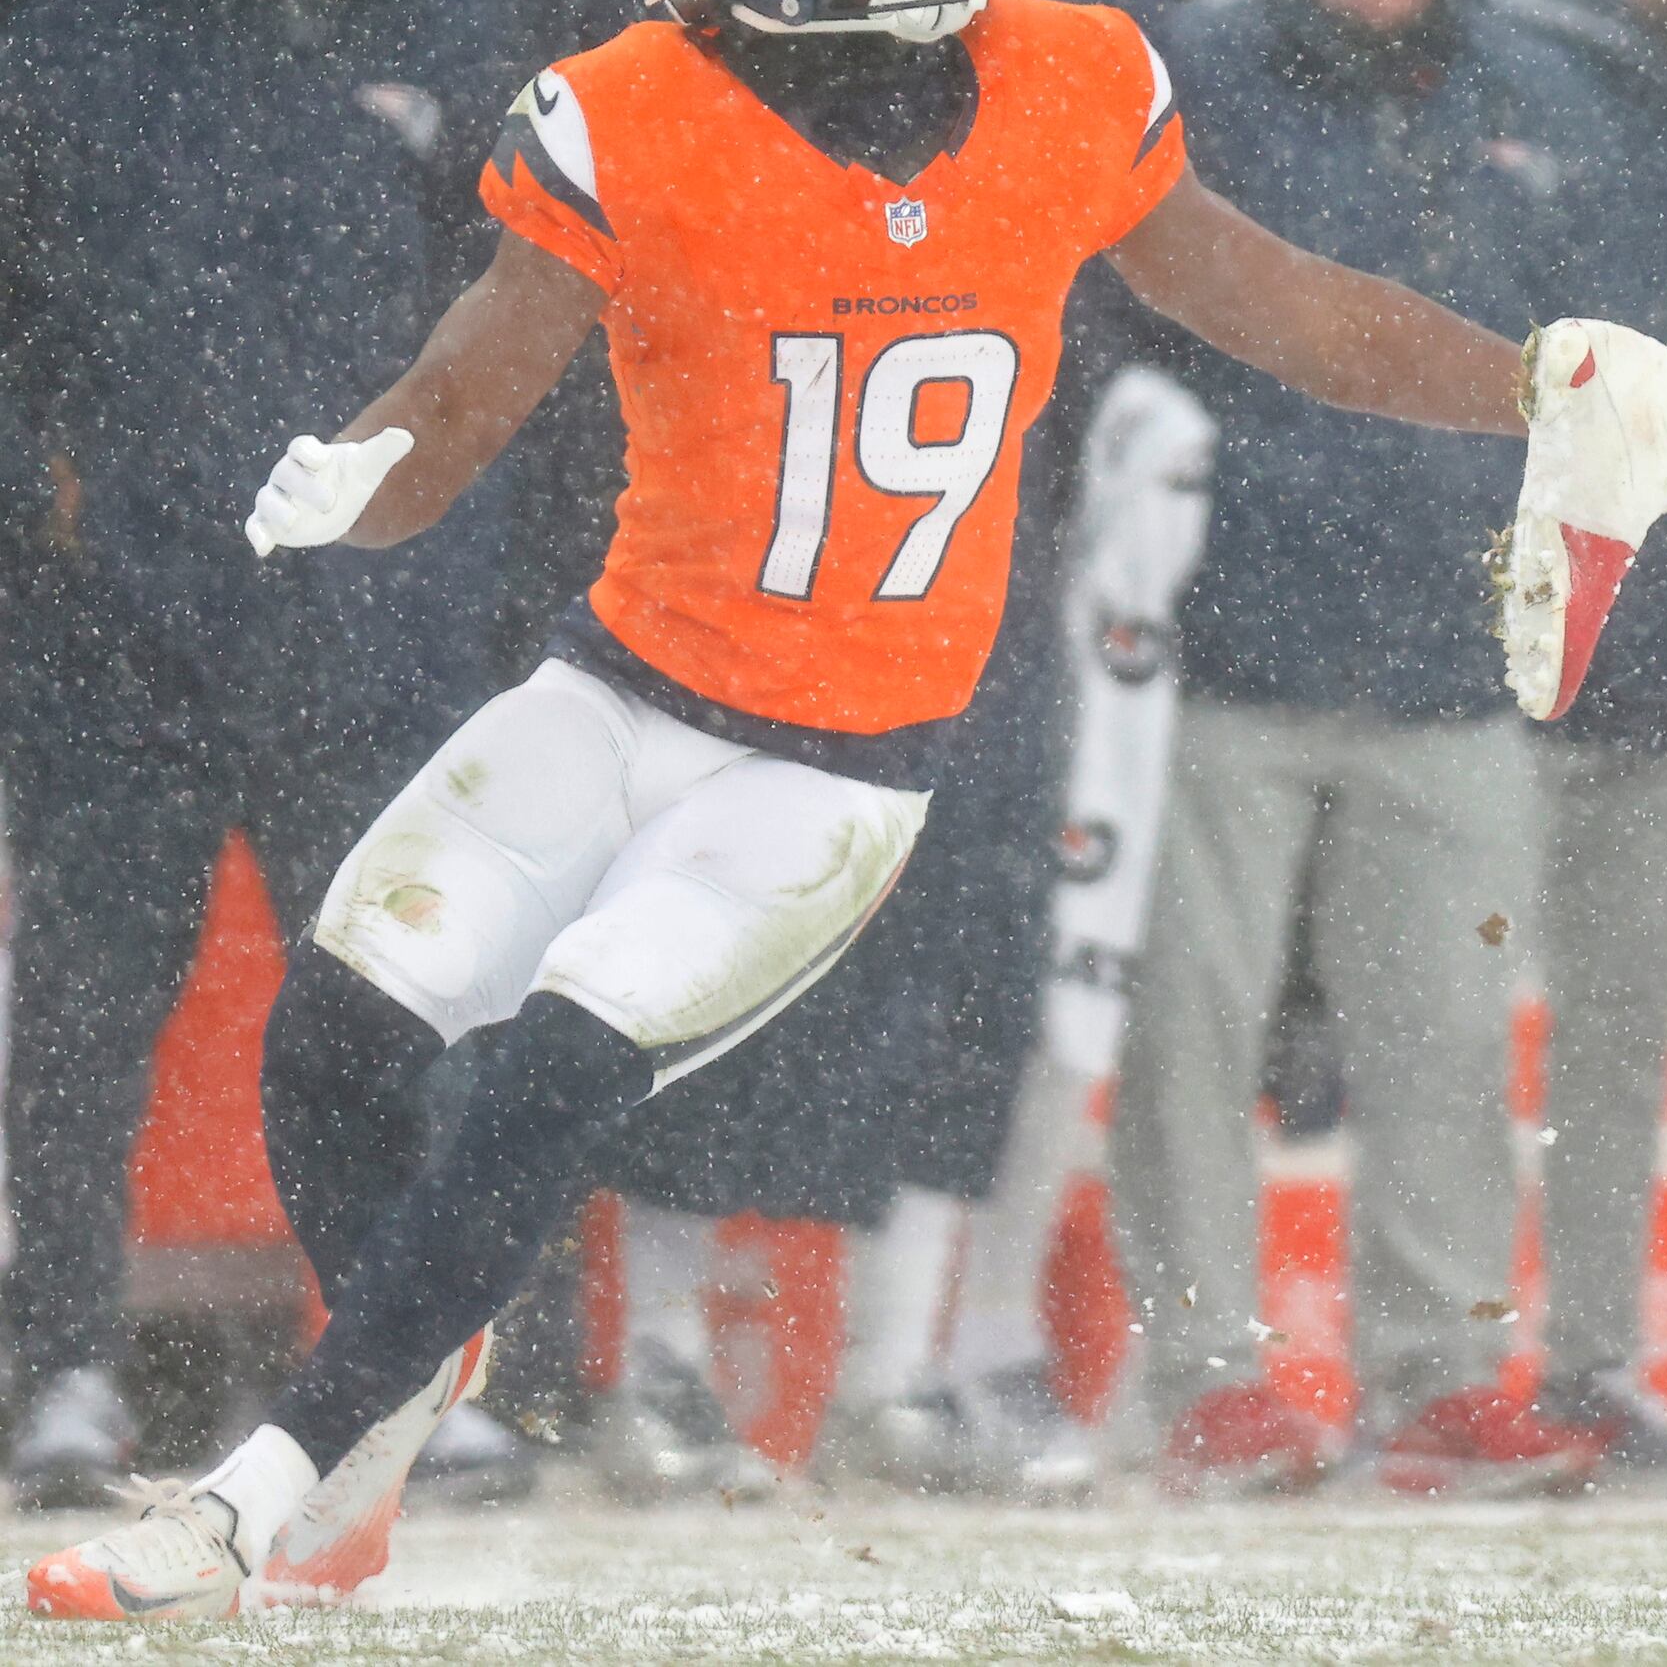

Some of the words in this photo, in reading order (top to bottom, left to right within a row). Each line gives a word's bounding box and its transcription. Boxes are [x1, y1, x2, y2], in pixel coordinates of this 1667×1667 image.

[894, 218, 921, 237] NFL
[832, 292, 978, 315] BRONCOS
[755, 329, 1020, 602] 19
